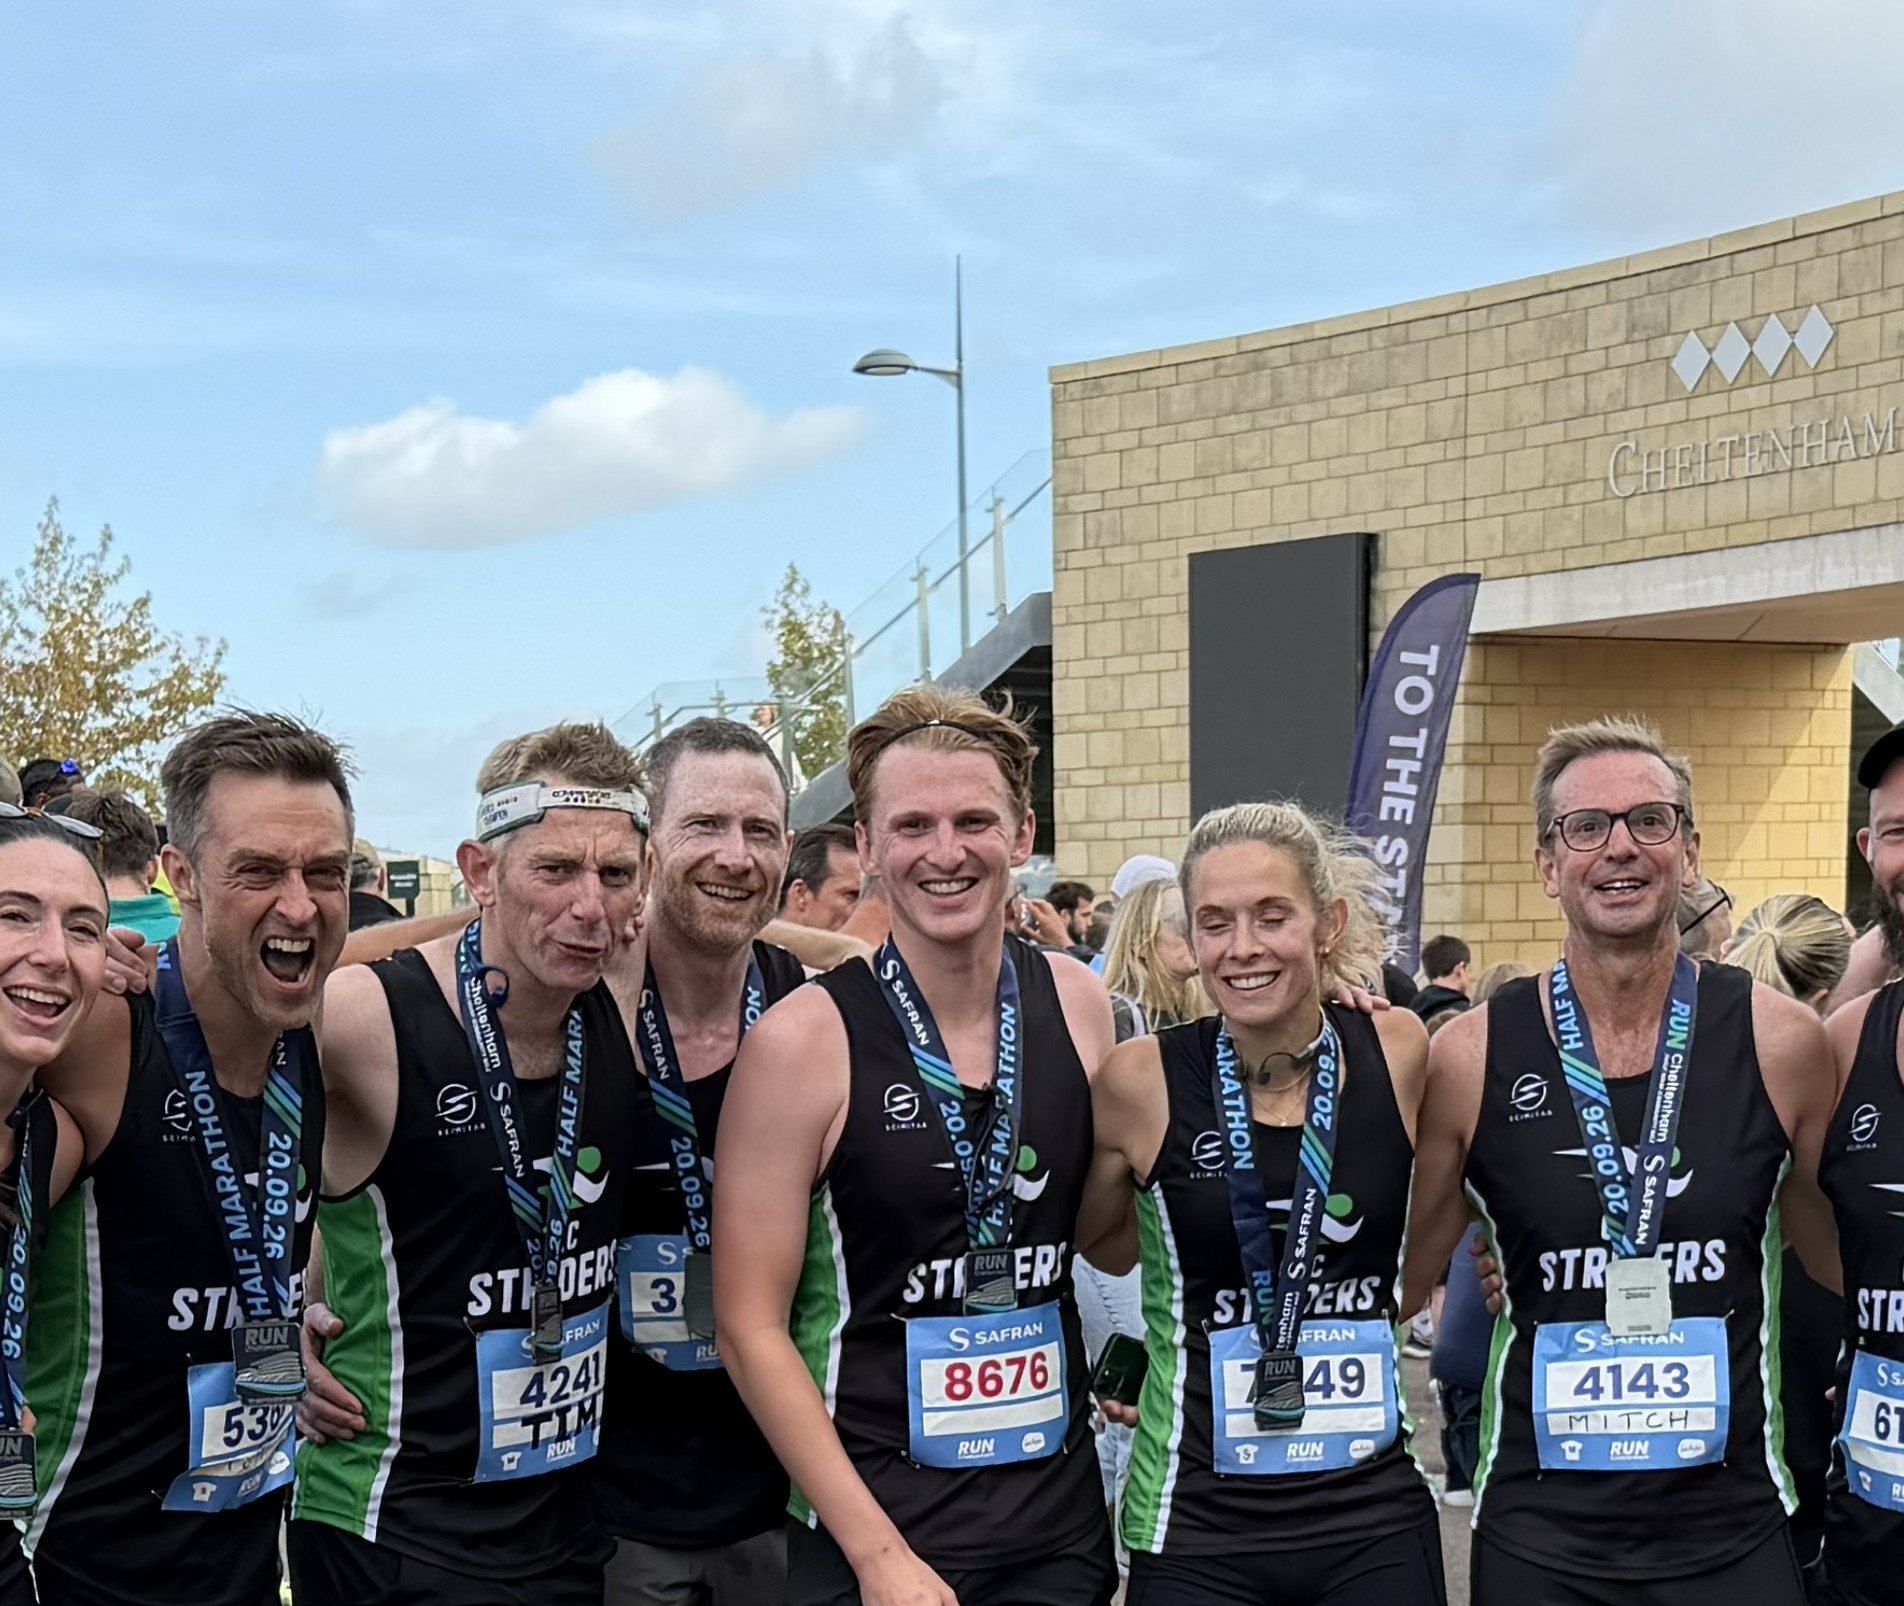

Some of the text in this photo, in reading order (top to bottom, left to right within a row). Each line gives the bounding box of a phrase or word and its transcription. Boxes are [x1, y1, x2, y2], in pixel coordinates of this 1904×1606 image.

[1608, 407, 1898, 498] CHELTENHAM
[1394, 645, 1440, 715] TO
[1379, 728, 1428, 825] THE
[892, 979, 930, 1046] SAFRAN
[1555, 999, 1584, 1050] HALF
[1666, 999, 1691, 1050] RUN
[644, 1010, 670, 1081] SAFRAN
[557, 1089, 580, 1156] HALF
[1656, 1053, 1683, 1143] Cheltenham
[499, 1105, 525, 1178] SAFRAN
[1583, 1106, 1630, 1215] 20.09.26
[185, 1071, 272, 1316] HALF MARATHON
[263, 1131, 292, 1259] 20.09.26
[671, 1136, 710, 1249] 20.09.26
[1636, 1176, 1656, 1245] SAFRAN
[1295, 1188, 1317, 1259] SAFRAN
[2, 1227, 27, 1359] 20.09.26
[1252, 1270, 1276, 1325] RUN
[245, 1327, 289, 1345] RUN
[563, 1320, 601, 1346] FRAN
[975, 1322, 1044, 1345] SAFRAN
[1298, 1328, 1356, 1343] FRAN
[520, 1353, 601, 1409] 4241
[945, 1351, 1049, 1402] 8676
[1240, 1357, 1366, 1403] 749
[1264, 1360, 1295, 1375] RUN
[1573, 1362, 1690, 1401] 4143
[521, 1404, 597, 1450] TIM
[958, 1438, 995, 1455] RUN
[1568, 1410, 1689, 1431] MITCH
[1610, 1441, 1649, 1455] RUN
[547, 1440, 575, 1457] RUN
[1287, 1442, 1324, 1456] RUN
